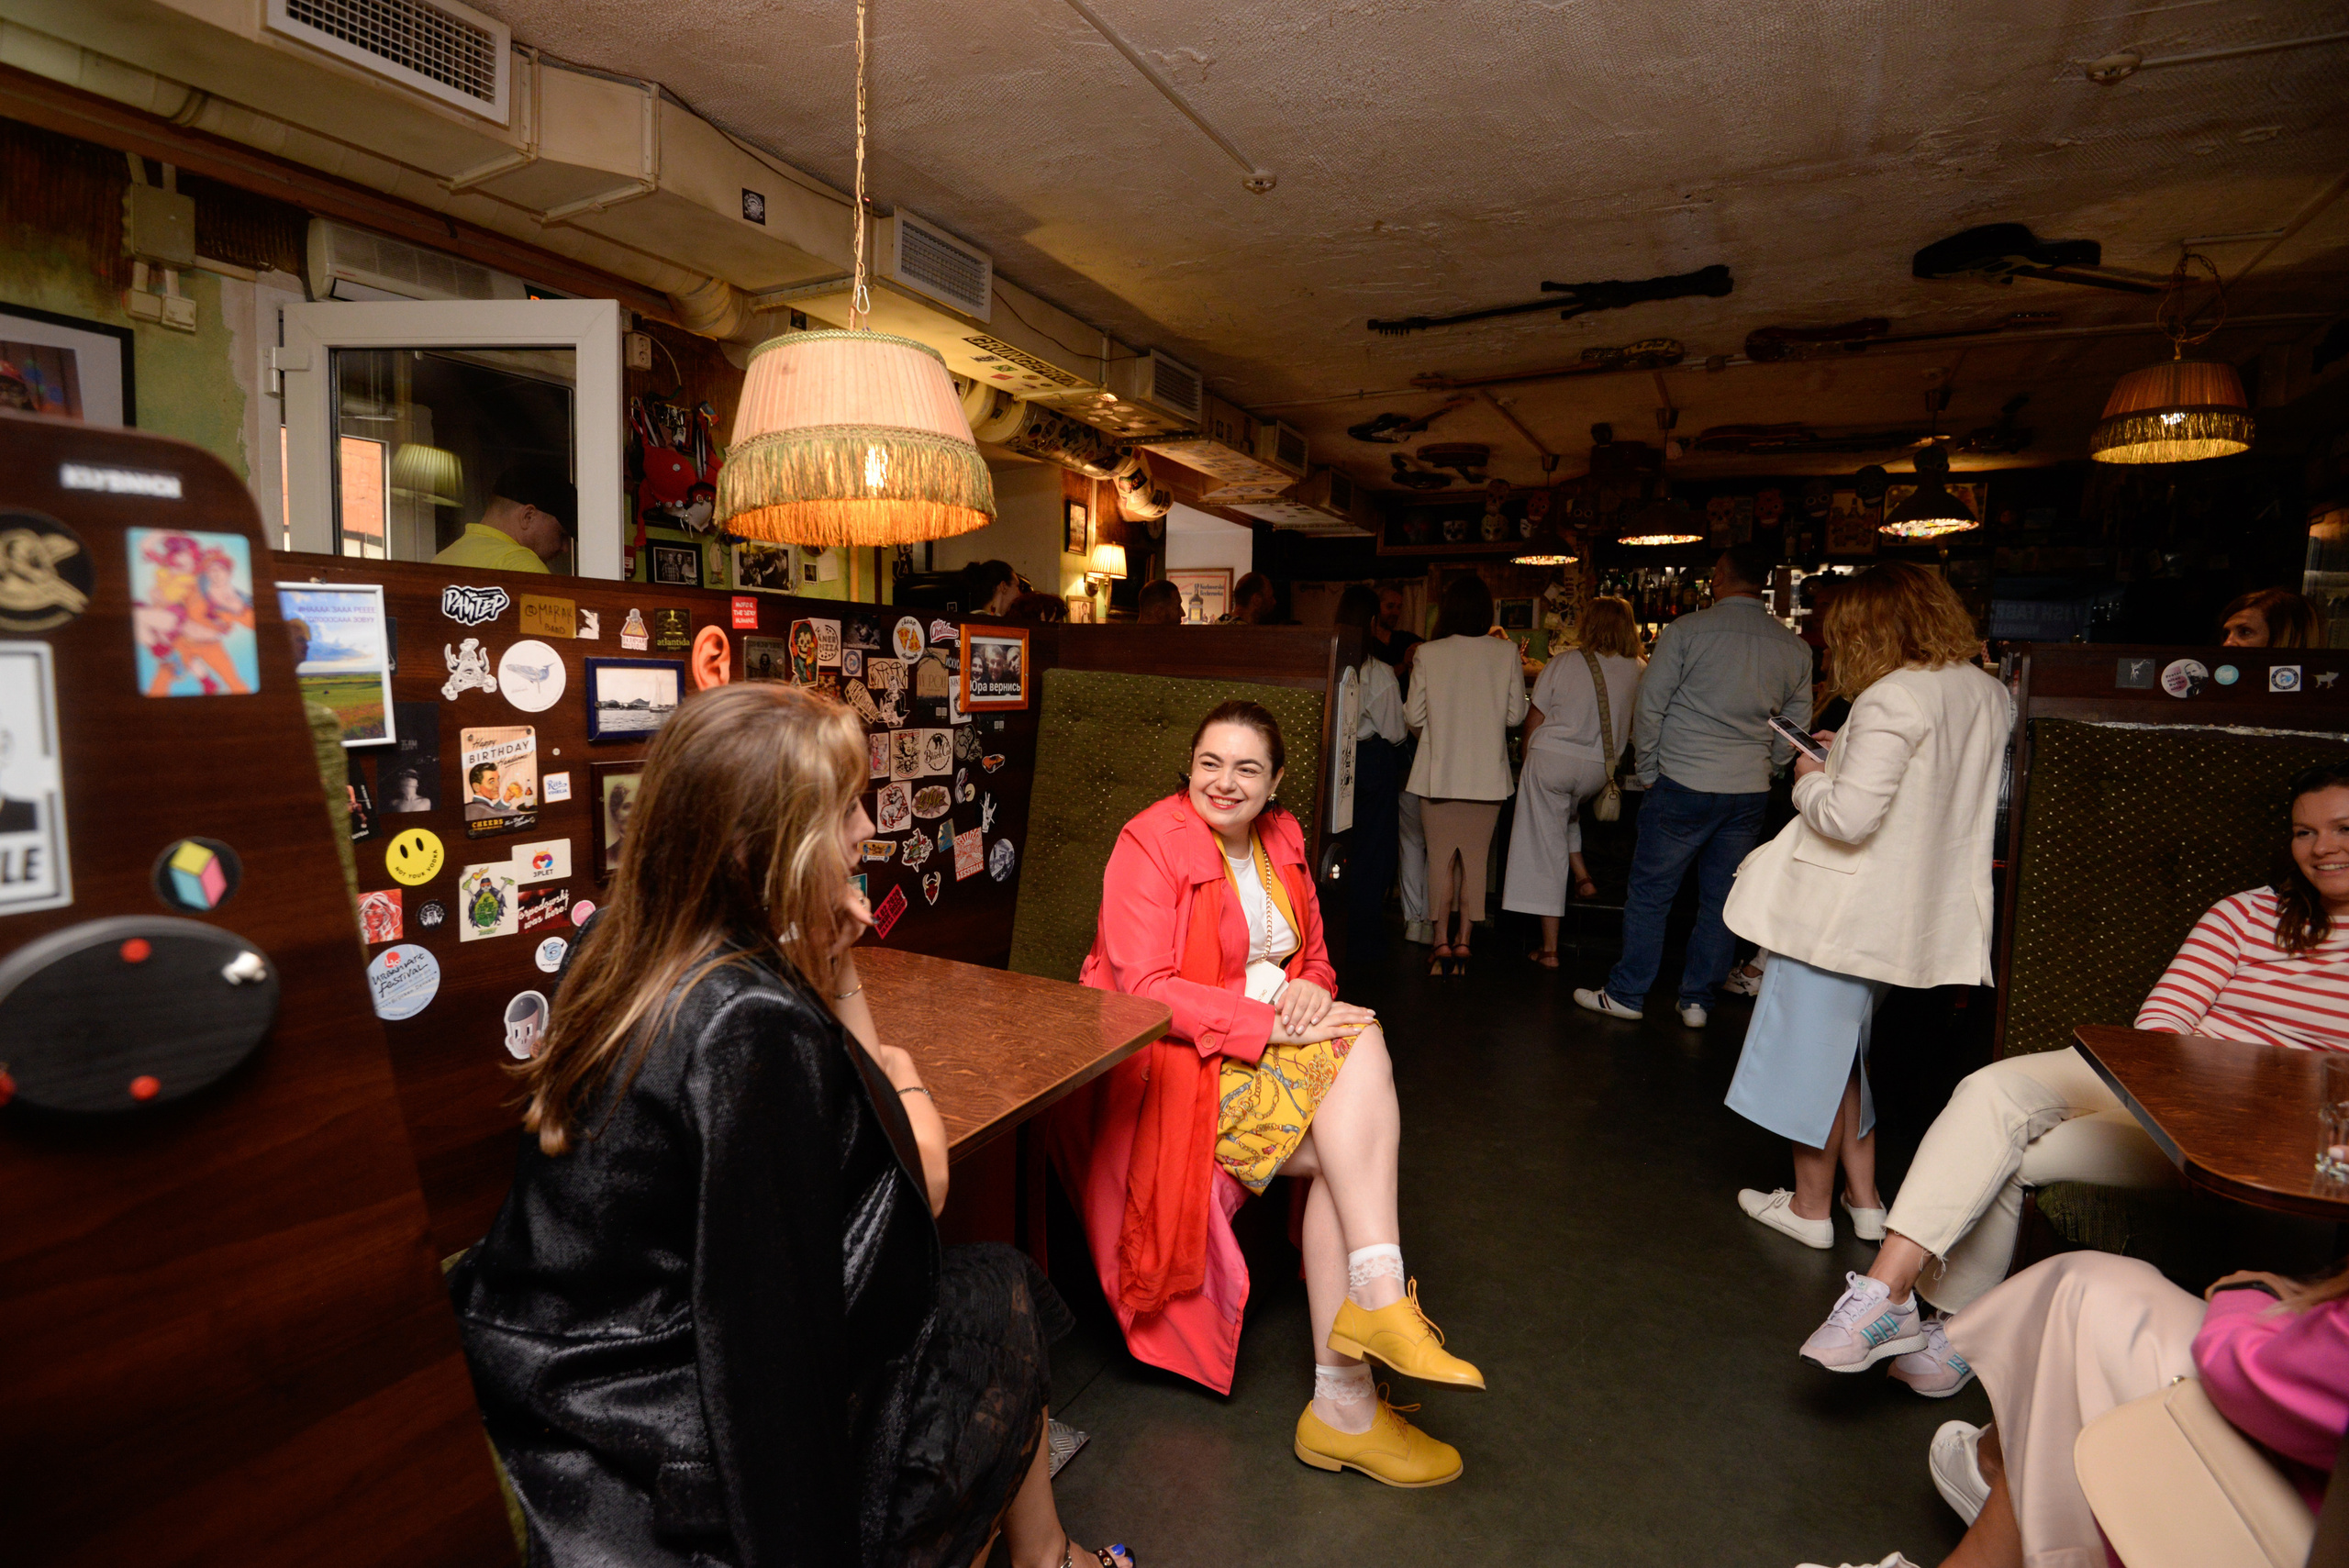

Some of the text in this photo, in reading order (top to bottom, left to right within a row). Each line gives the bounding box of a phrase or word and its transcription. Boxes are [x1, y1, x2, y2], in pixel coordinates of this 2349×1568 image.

[966, 336, 1078, 387] GRUNGEPRO
[656, 637, 691, 646] atlantida
[970, 680, 988, 695] Юра
[989, 682, 1021, 695] вернись
[472, 737, 497, 749] Happy
[469, 740, 530, 764] BIRTHDAY
[472, 818, 504, 828] CHEERS
[395, 866, 406, 876] NOT
[427, 849, 439, 872] VODKA
[956, 863, 985, 881] LESSTALK
[524, 917, 543, 929] was
